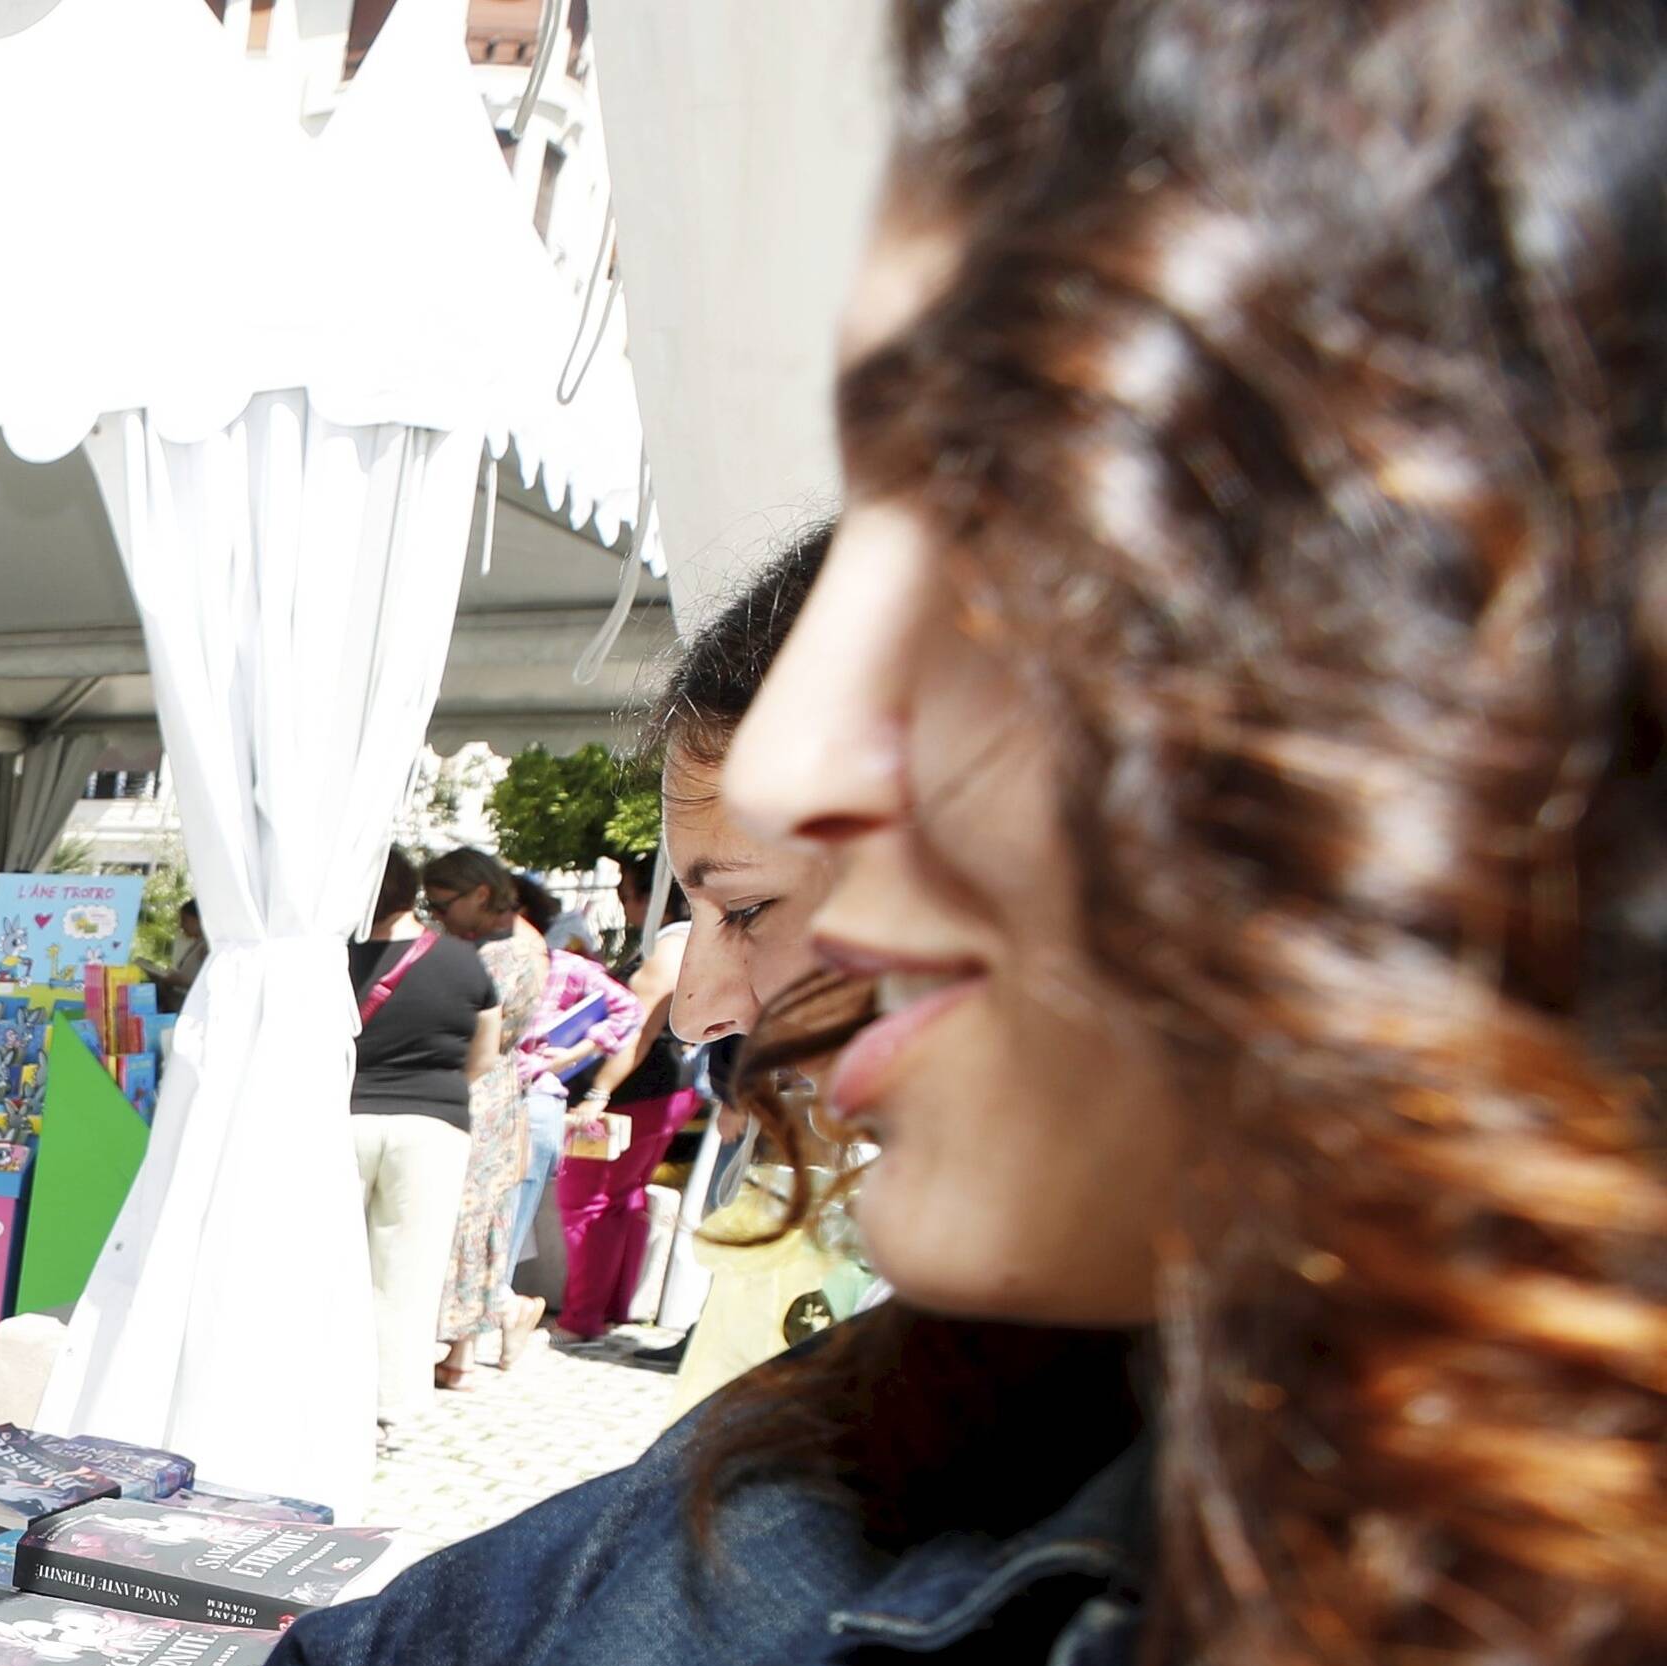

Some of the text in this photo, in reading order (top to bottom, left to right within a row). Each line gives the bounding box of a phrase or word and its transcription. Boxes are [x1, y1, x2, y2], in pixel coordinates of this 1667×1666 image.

[63, 886, 116, 899] TROTRO
[98, 1576, 180, 1608] SANGLANTE
[207, 1598, 258, 1616] GHANEM
[207, 1609, 254, 1626] OCÉANE
